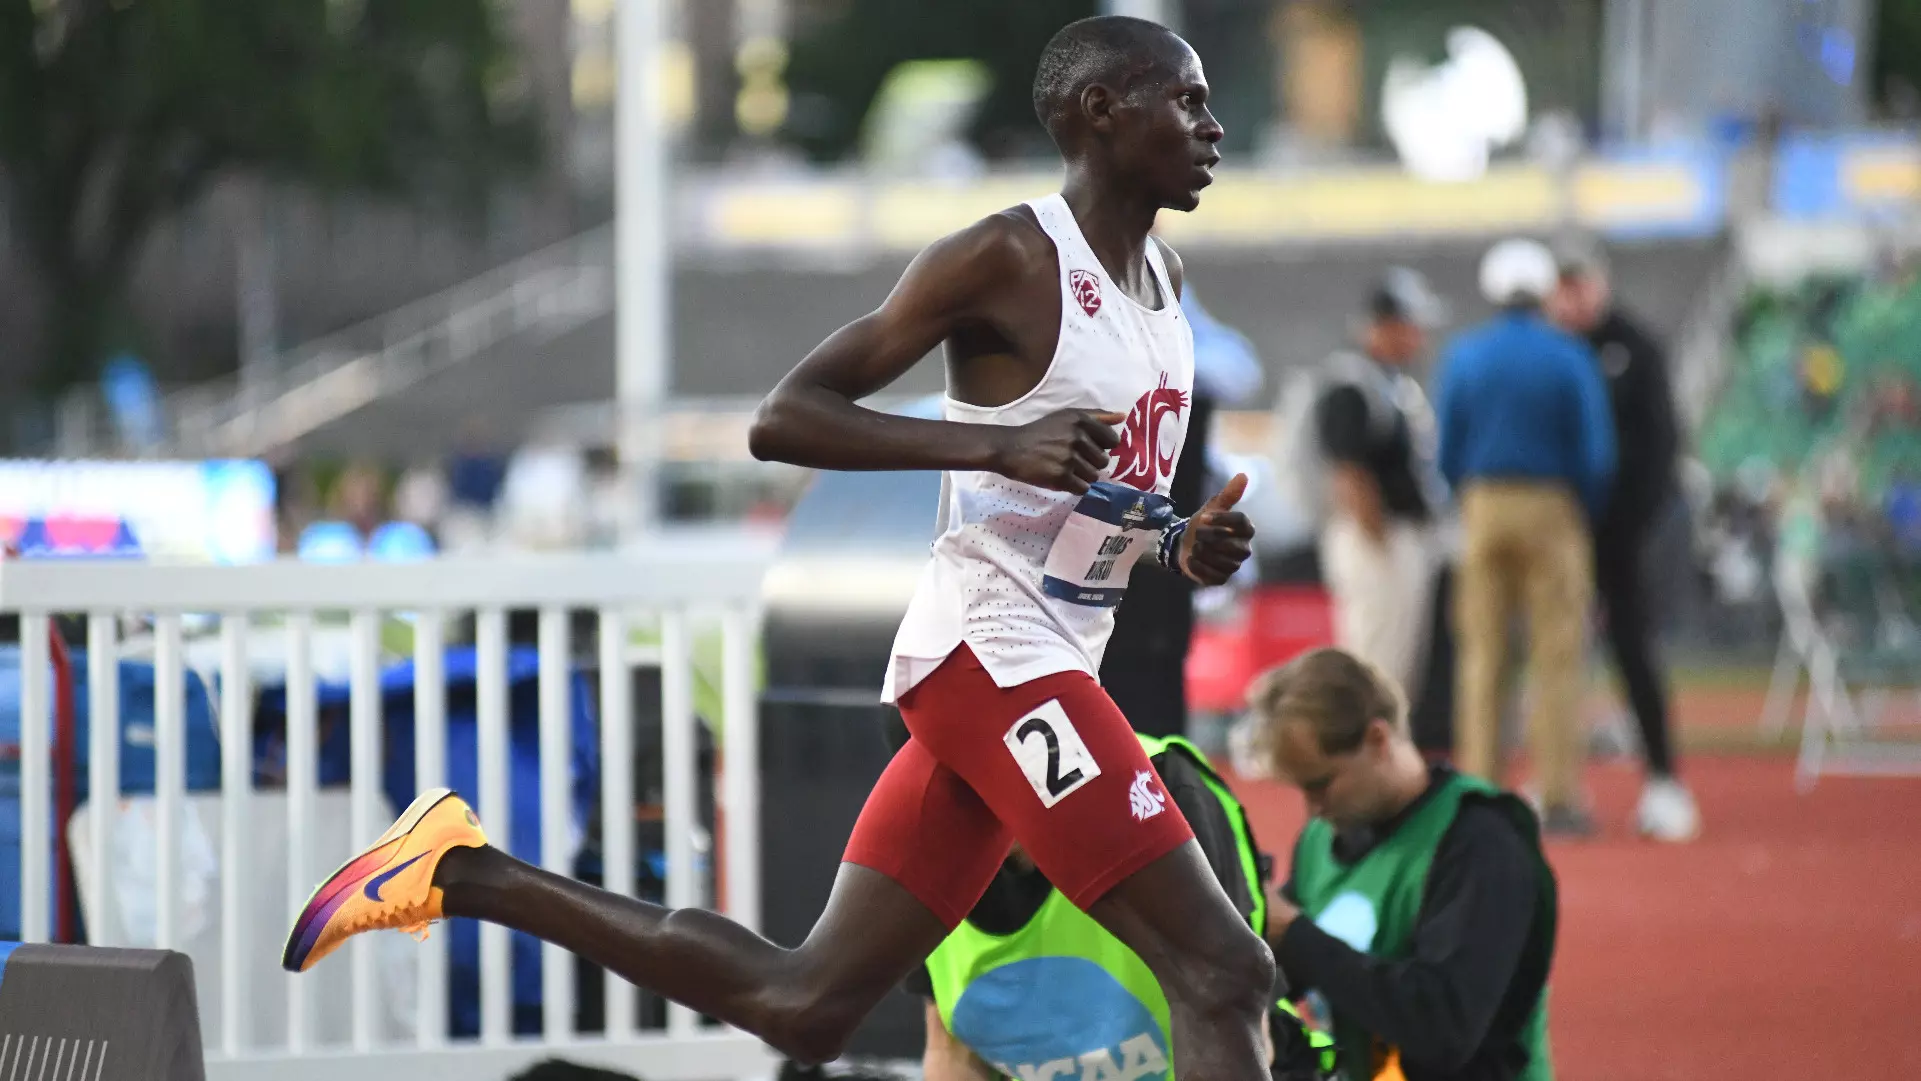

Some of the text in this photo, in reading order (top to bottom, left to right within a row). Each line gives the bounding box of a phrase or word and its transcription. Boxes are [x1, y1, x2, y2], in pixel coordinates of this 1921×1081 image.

[1080, 289, 1101, 308] 12
[1016, 717, 1084, 797] 2
[993, 1032, 1168, 1081] CAA
